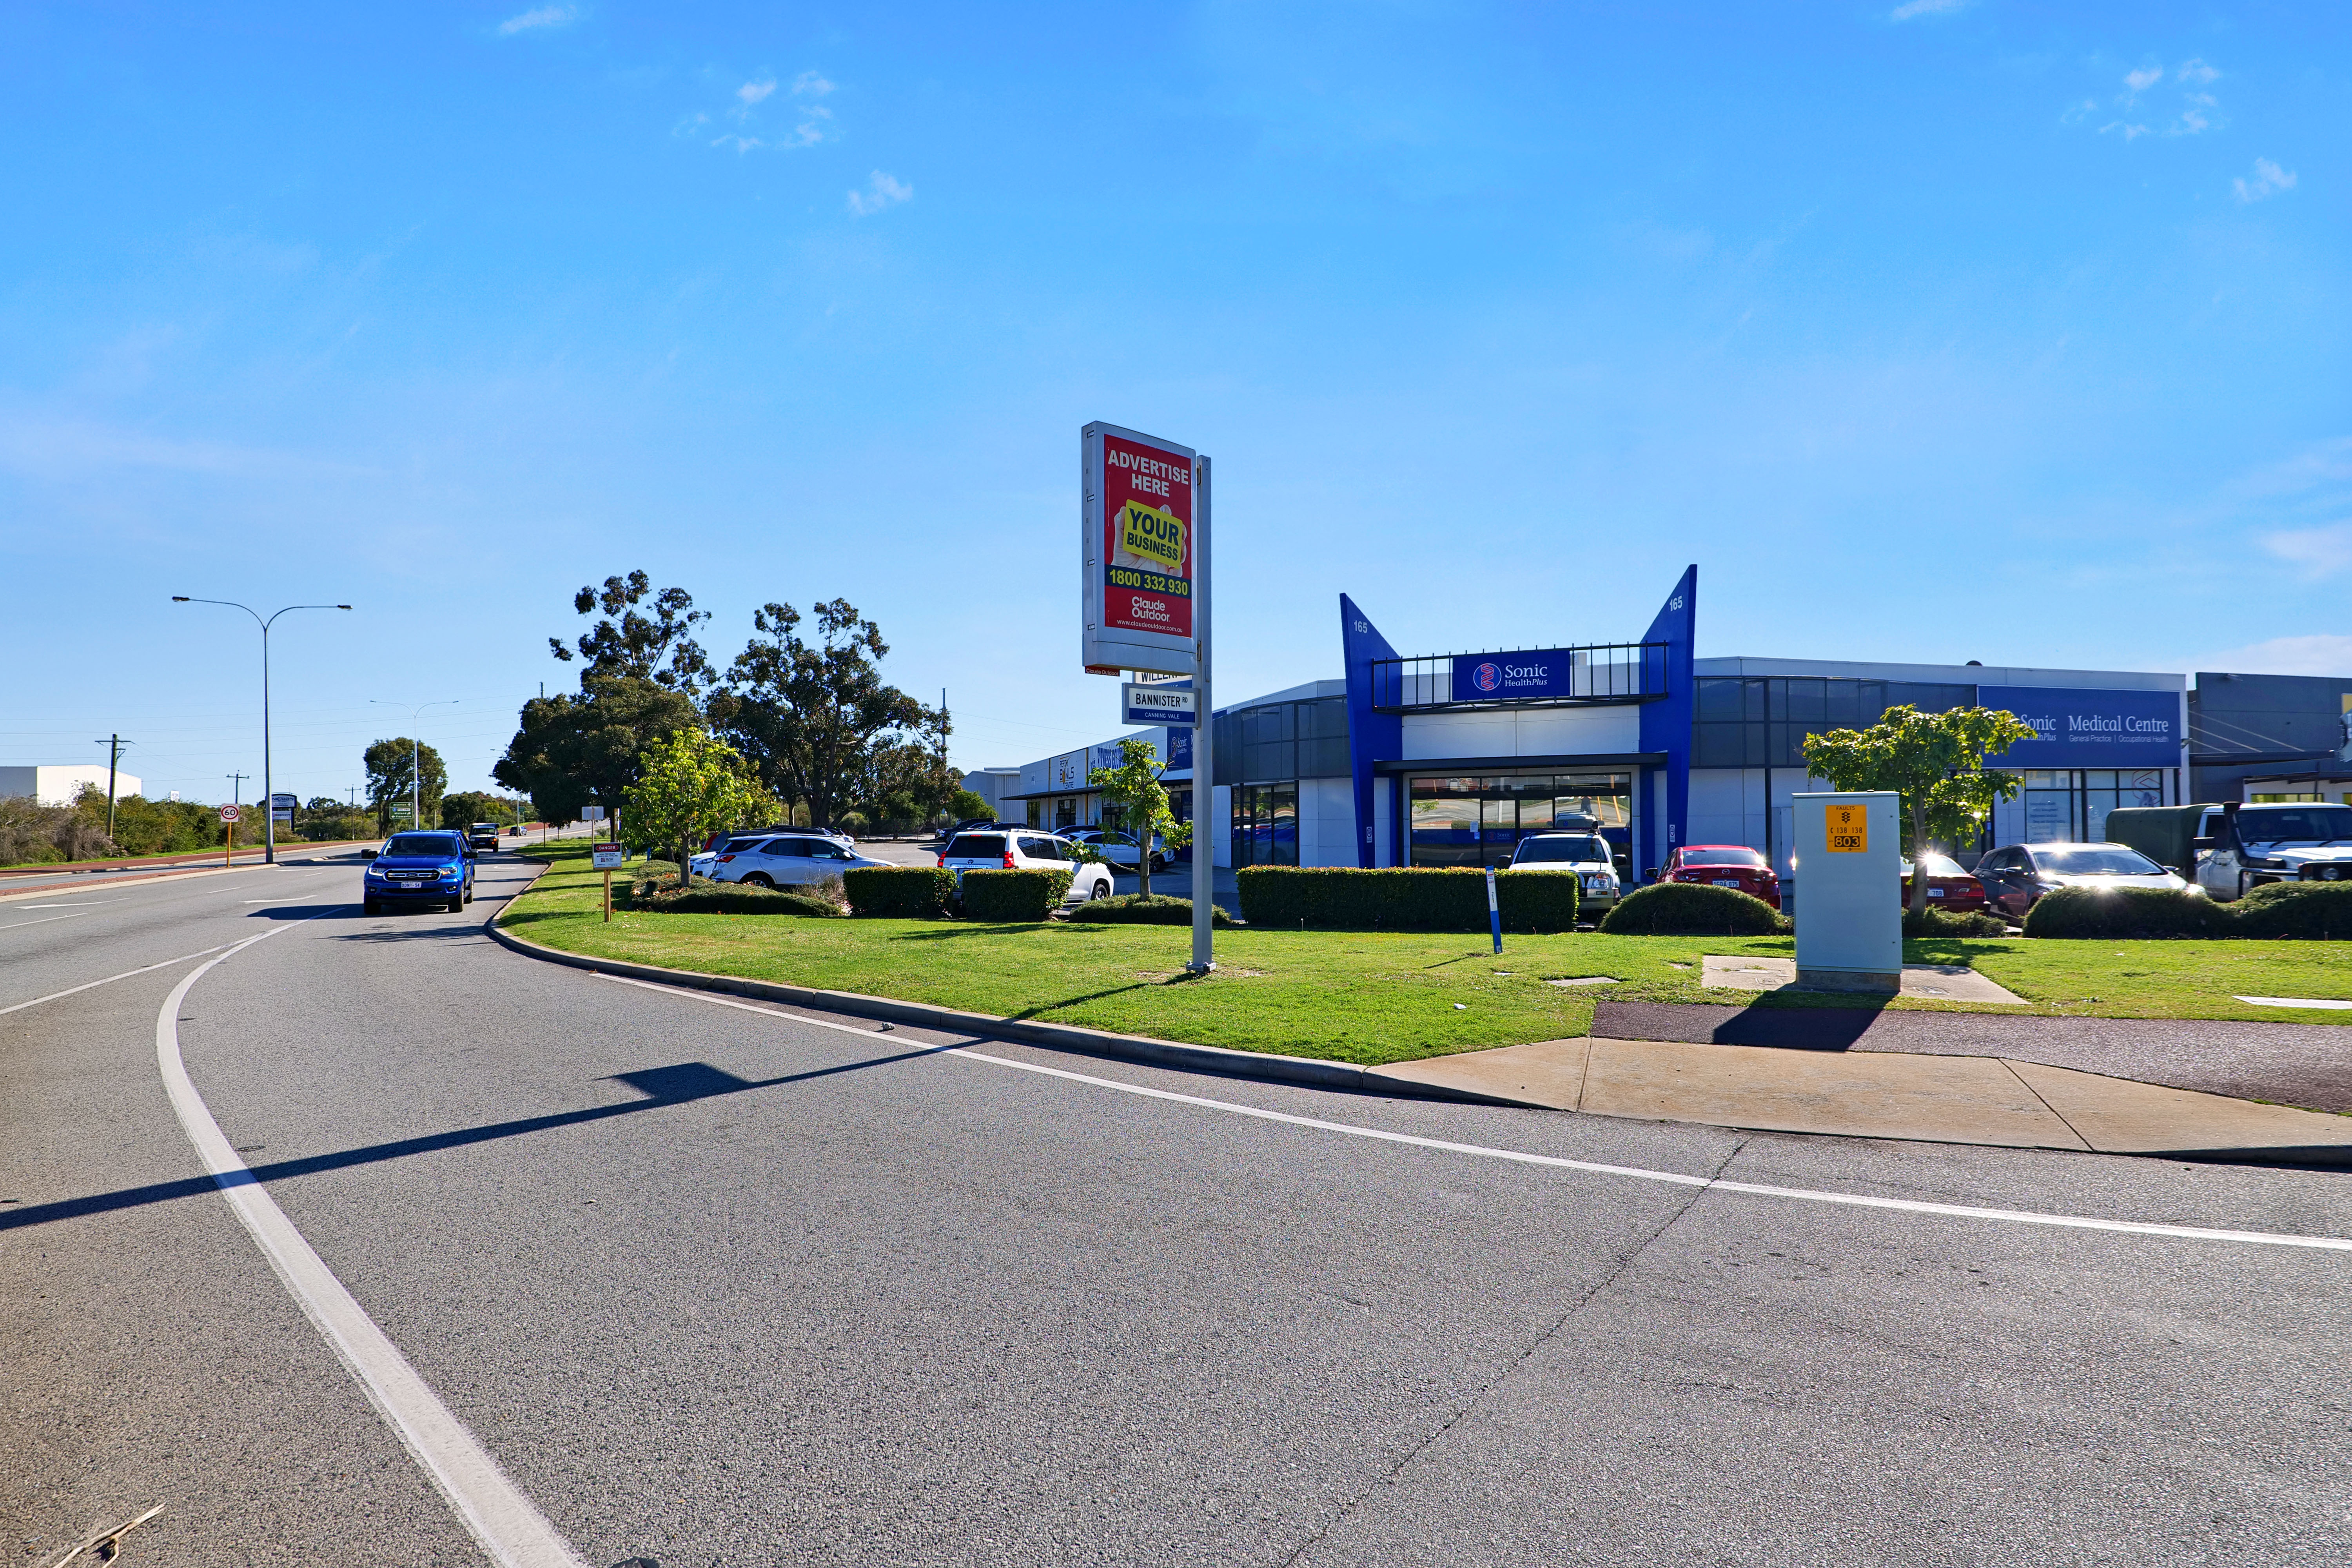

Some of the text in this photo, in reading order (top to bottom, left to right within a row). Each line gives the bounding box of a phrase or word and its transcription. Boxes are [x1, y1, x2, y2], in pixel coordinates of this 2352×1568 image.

[1108, 450, 1189, 485] ADVERTISE
[1132, 473, 1169, 497] HERE
[1129, 508, 1179, 546] YOUR
[1127, 532, 1178, 561] BUSINESS
[1110, 569, 1188, 595] 1800 332 930
[1132, 596, 1165, 611] Claude
[1670, 595, 1682, 612] 165
[1132, 607, 1170, 622] Outdoor
[1117, 619, 1183, 633] www.claudeoutdoor.com.au
[1354, 620, 1368, 633] 165
[1505, 664, 1548, 678] Sonic
[1136, 693, 1180, 707] BANNISTER
[2021, 714, 2169, 732] Sonic Medical Centre
[2119, 735, 2151, 743] Occupational
[1835, 837, 1859, 846] 803
